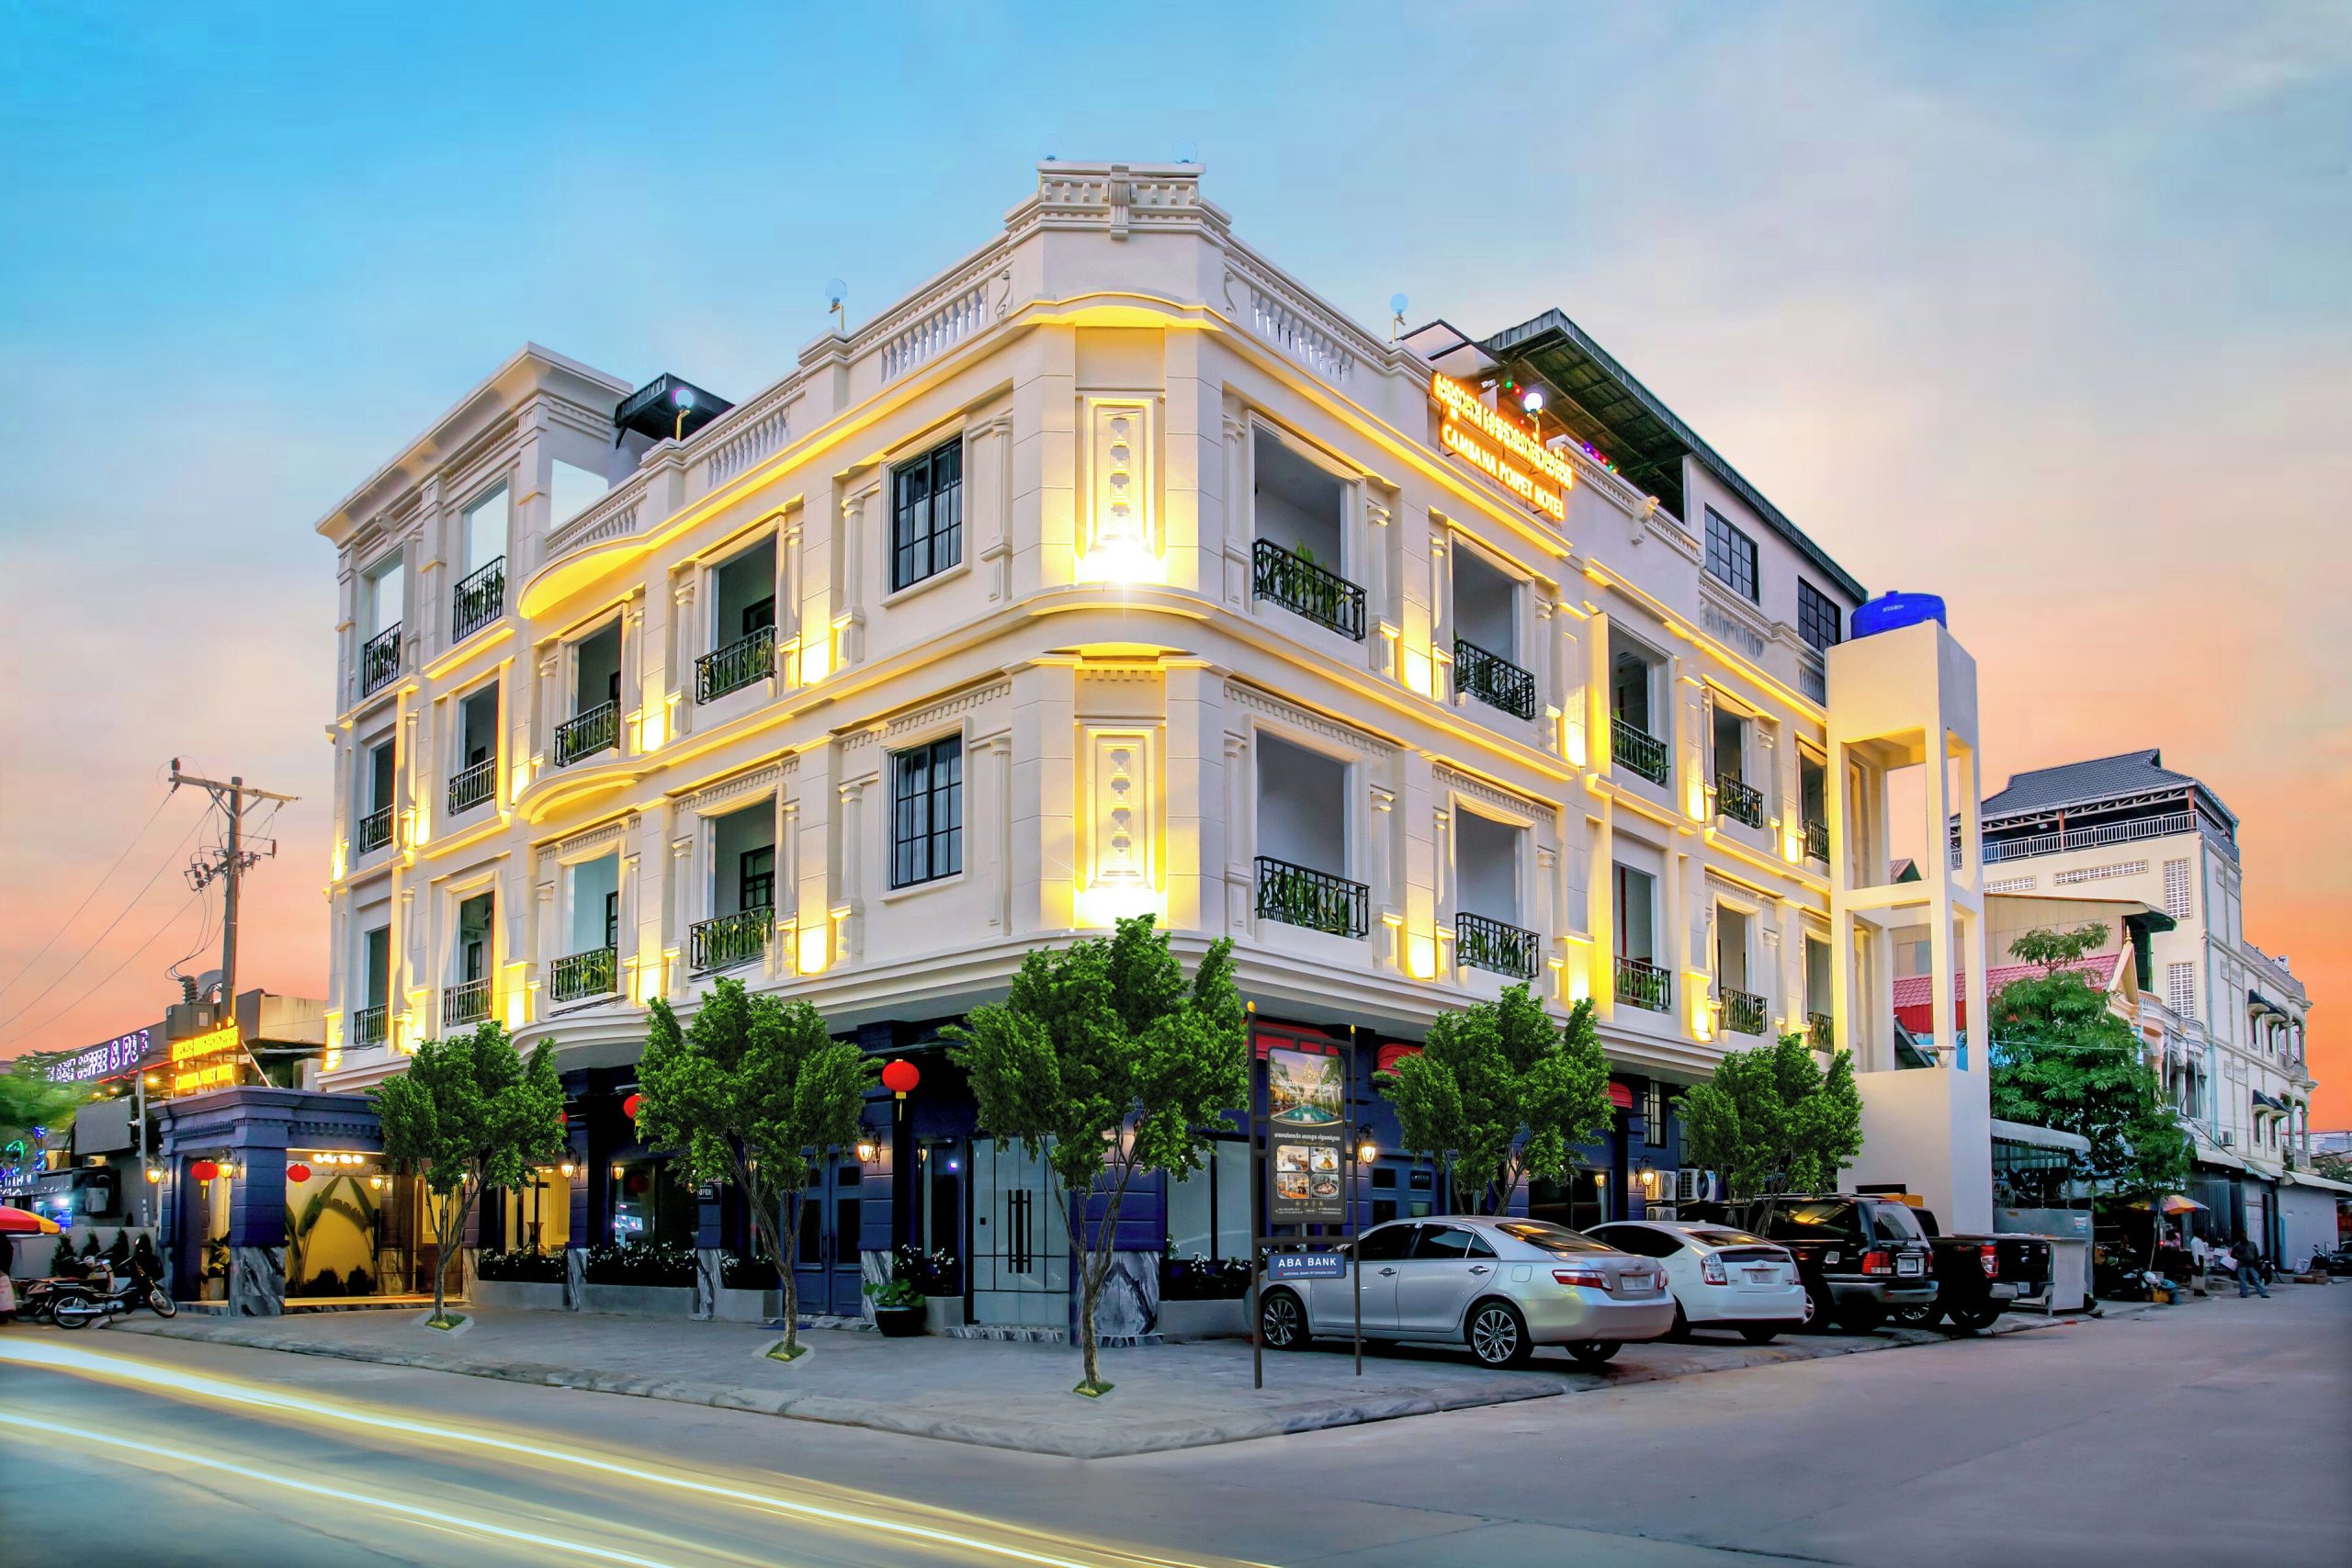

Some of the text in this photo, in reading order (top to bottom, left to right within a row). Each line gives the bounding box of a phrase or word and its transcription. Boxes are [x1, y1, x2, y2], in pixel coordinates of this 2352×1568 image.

[1534, 484, 1566, 521] HOTEL
[110, 1040, 120, 1070] &
[1278, 1258, 1337, 1268] ABA BANK
